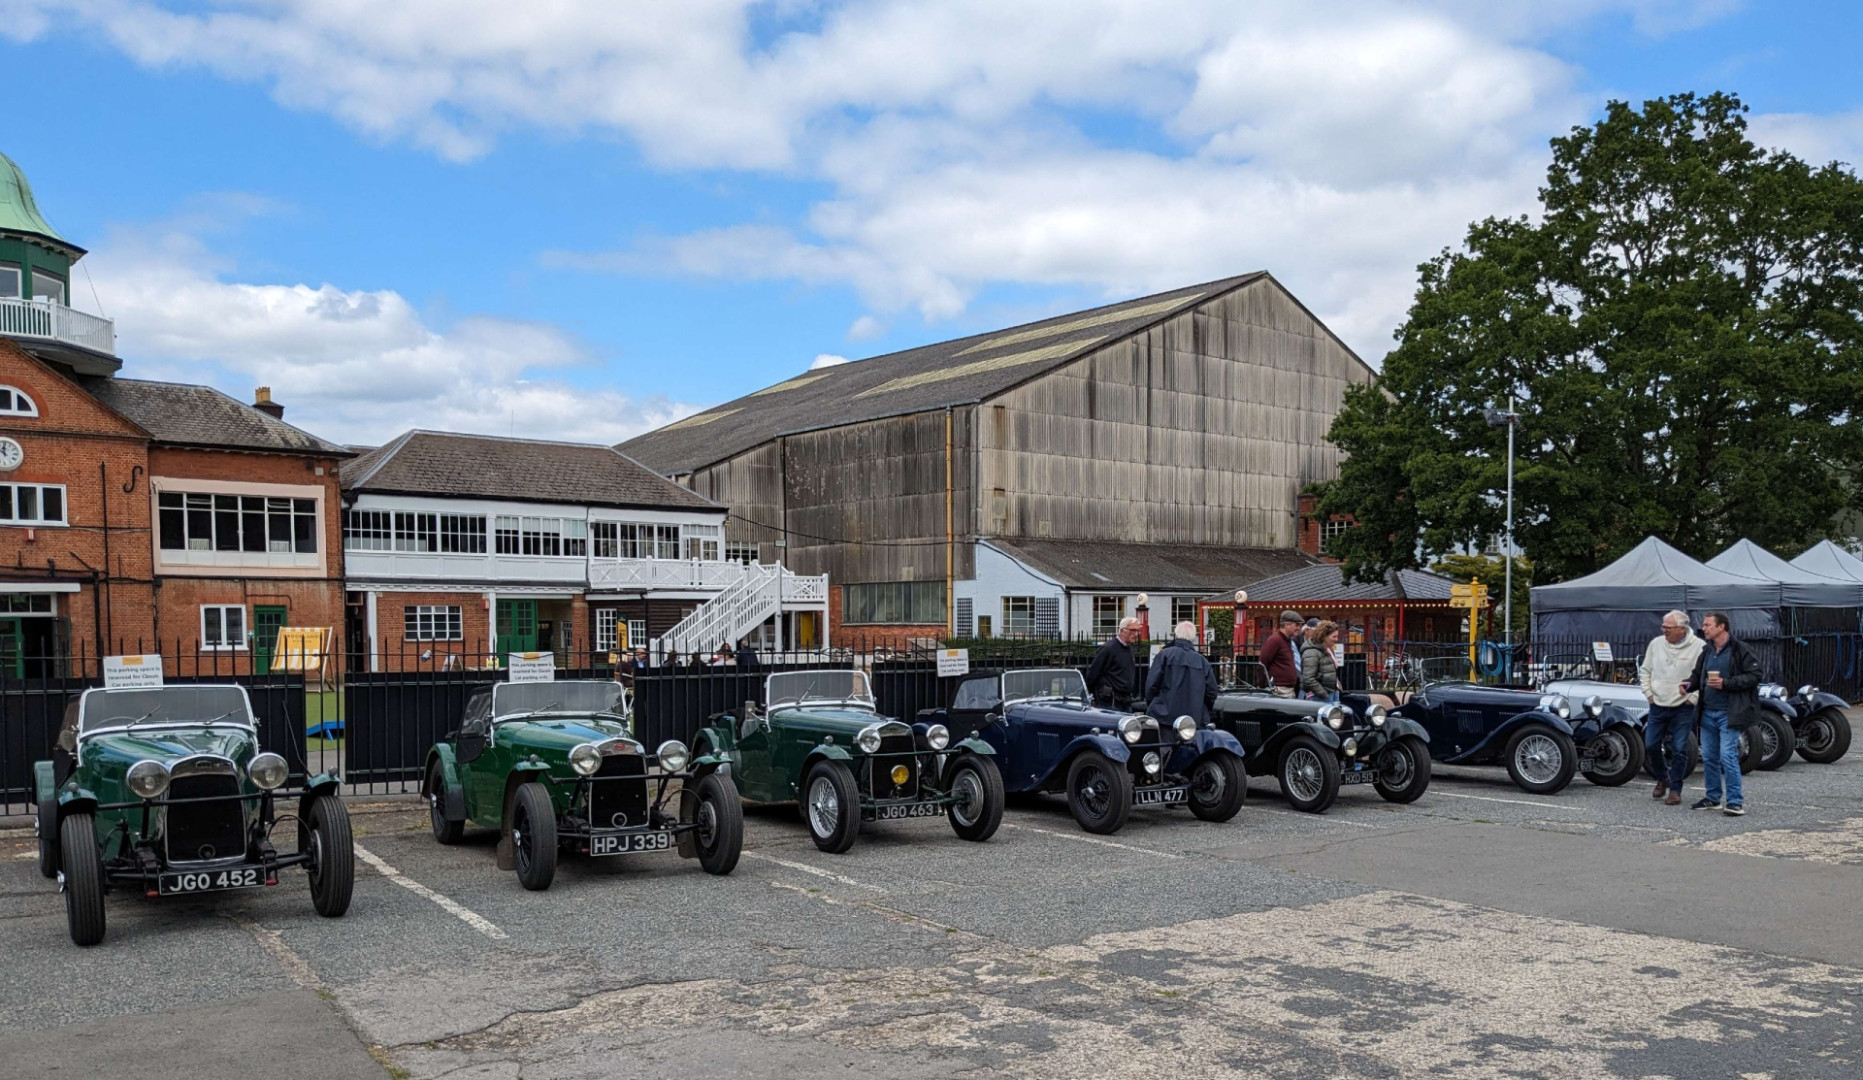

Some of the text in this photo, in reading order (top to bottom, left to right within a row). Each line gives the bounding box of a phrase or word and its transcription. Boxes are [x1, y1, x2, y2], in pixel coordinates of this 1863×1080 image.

[1345, 772, 1374, 784] HXD 513
[1141, 790, 1183, 803] LLN 477
[882, 804, 934, 818] JGO 463
[594, 834, 668, 853] HPJ 339
[169, 869, 257, 891] JGO 452
